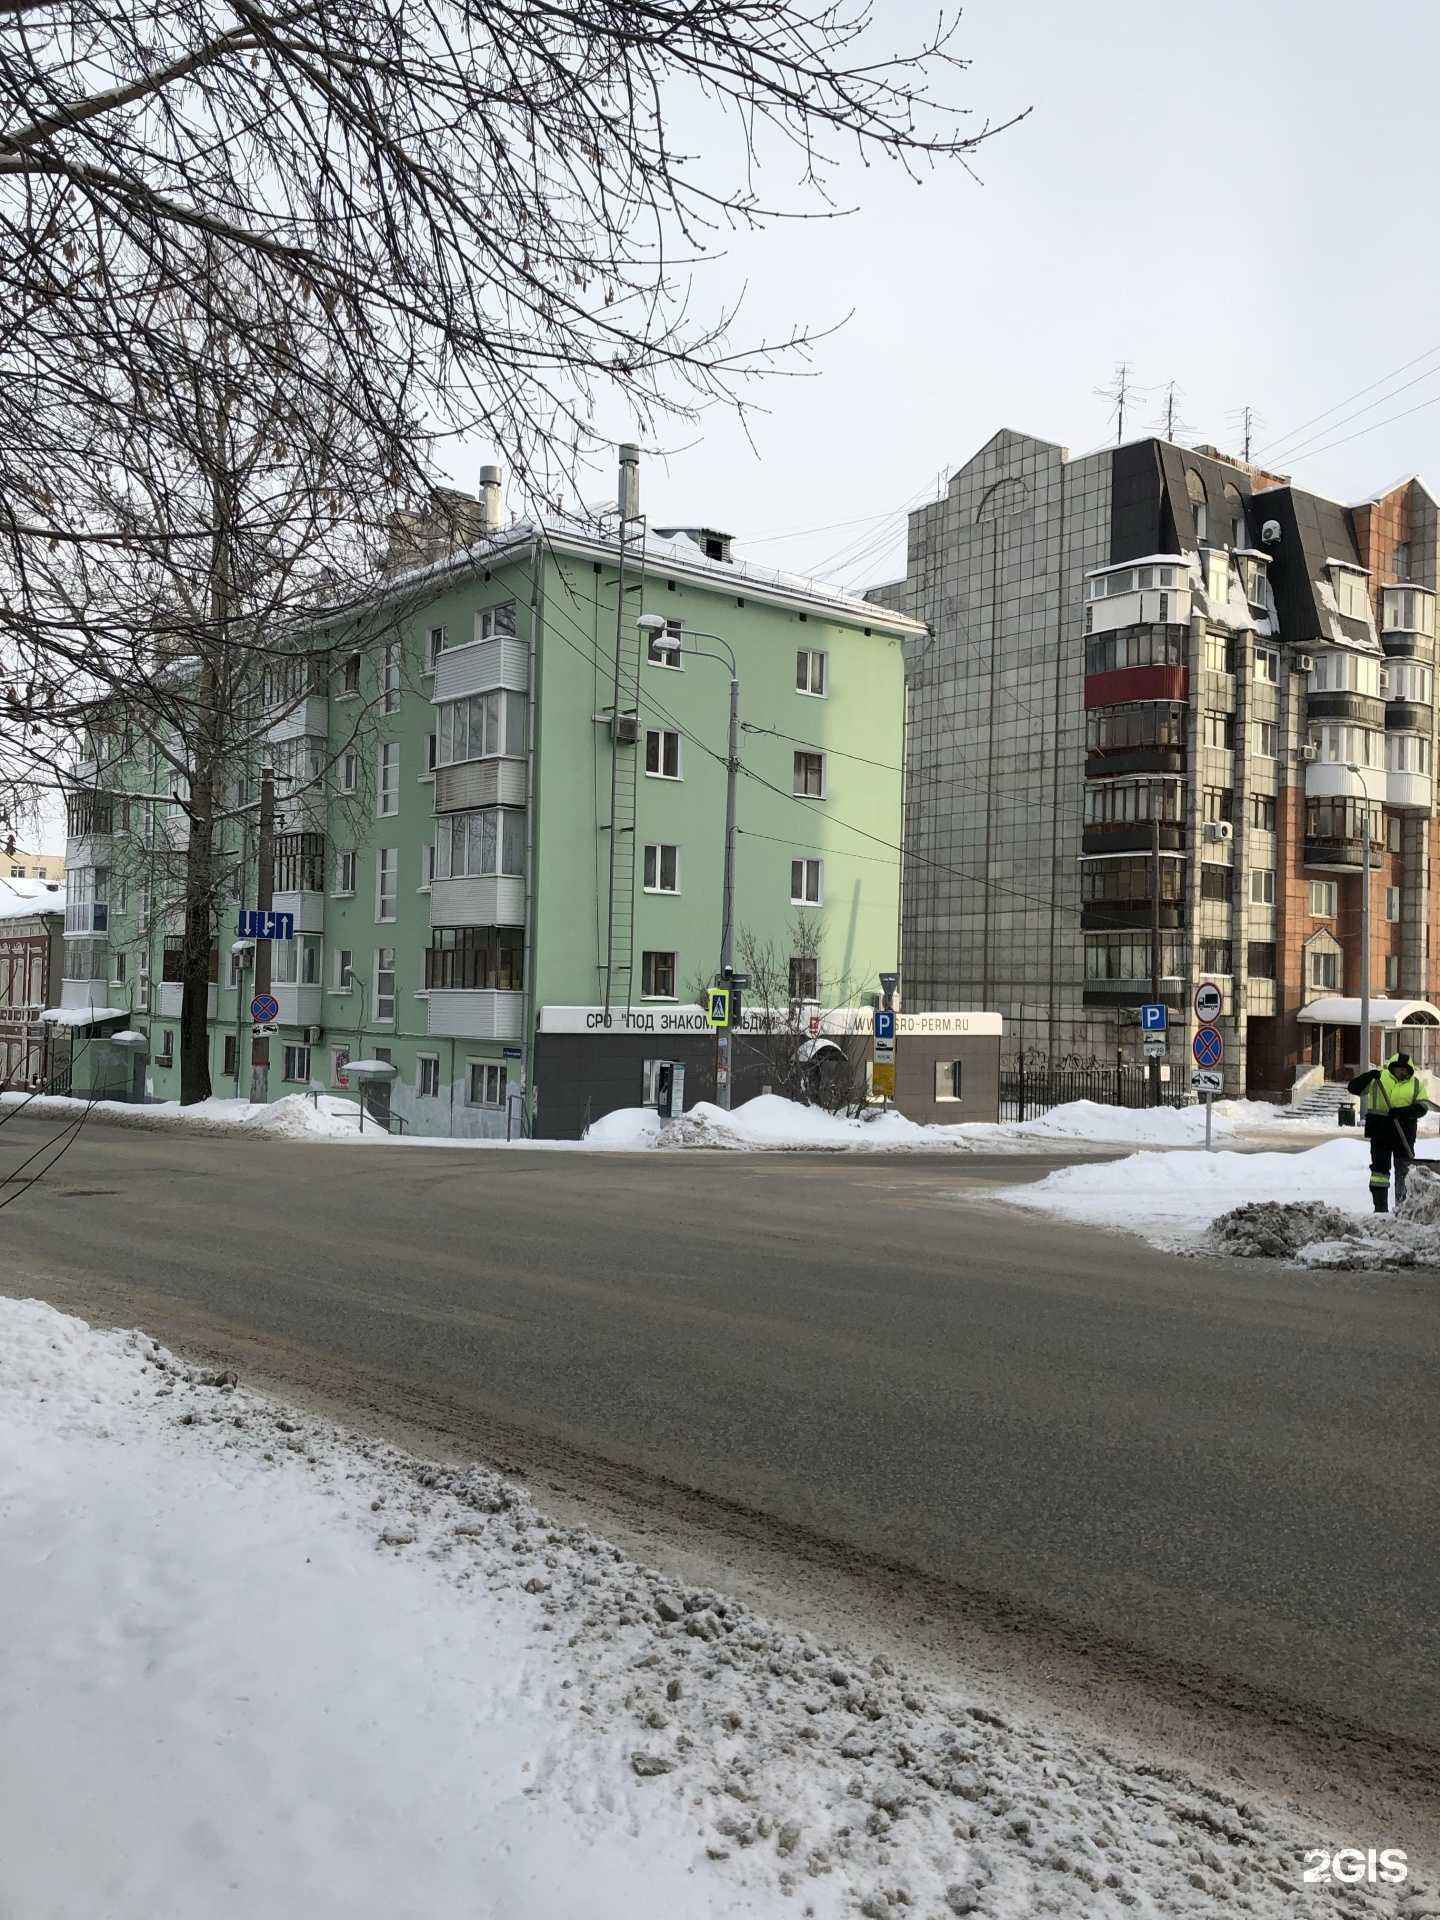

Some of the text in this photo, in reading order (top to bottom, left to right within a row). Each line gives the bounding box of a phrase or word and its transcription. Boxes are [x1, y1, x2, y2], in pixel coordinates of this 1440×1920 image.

[586, 1013, 612, 1029] СРО
[880, 1014, 890, 1036] P
[1147, 1008, 1160, 1028] P
